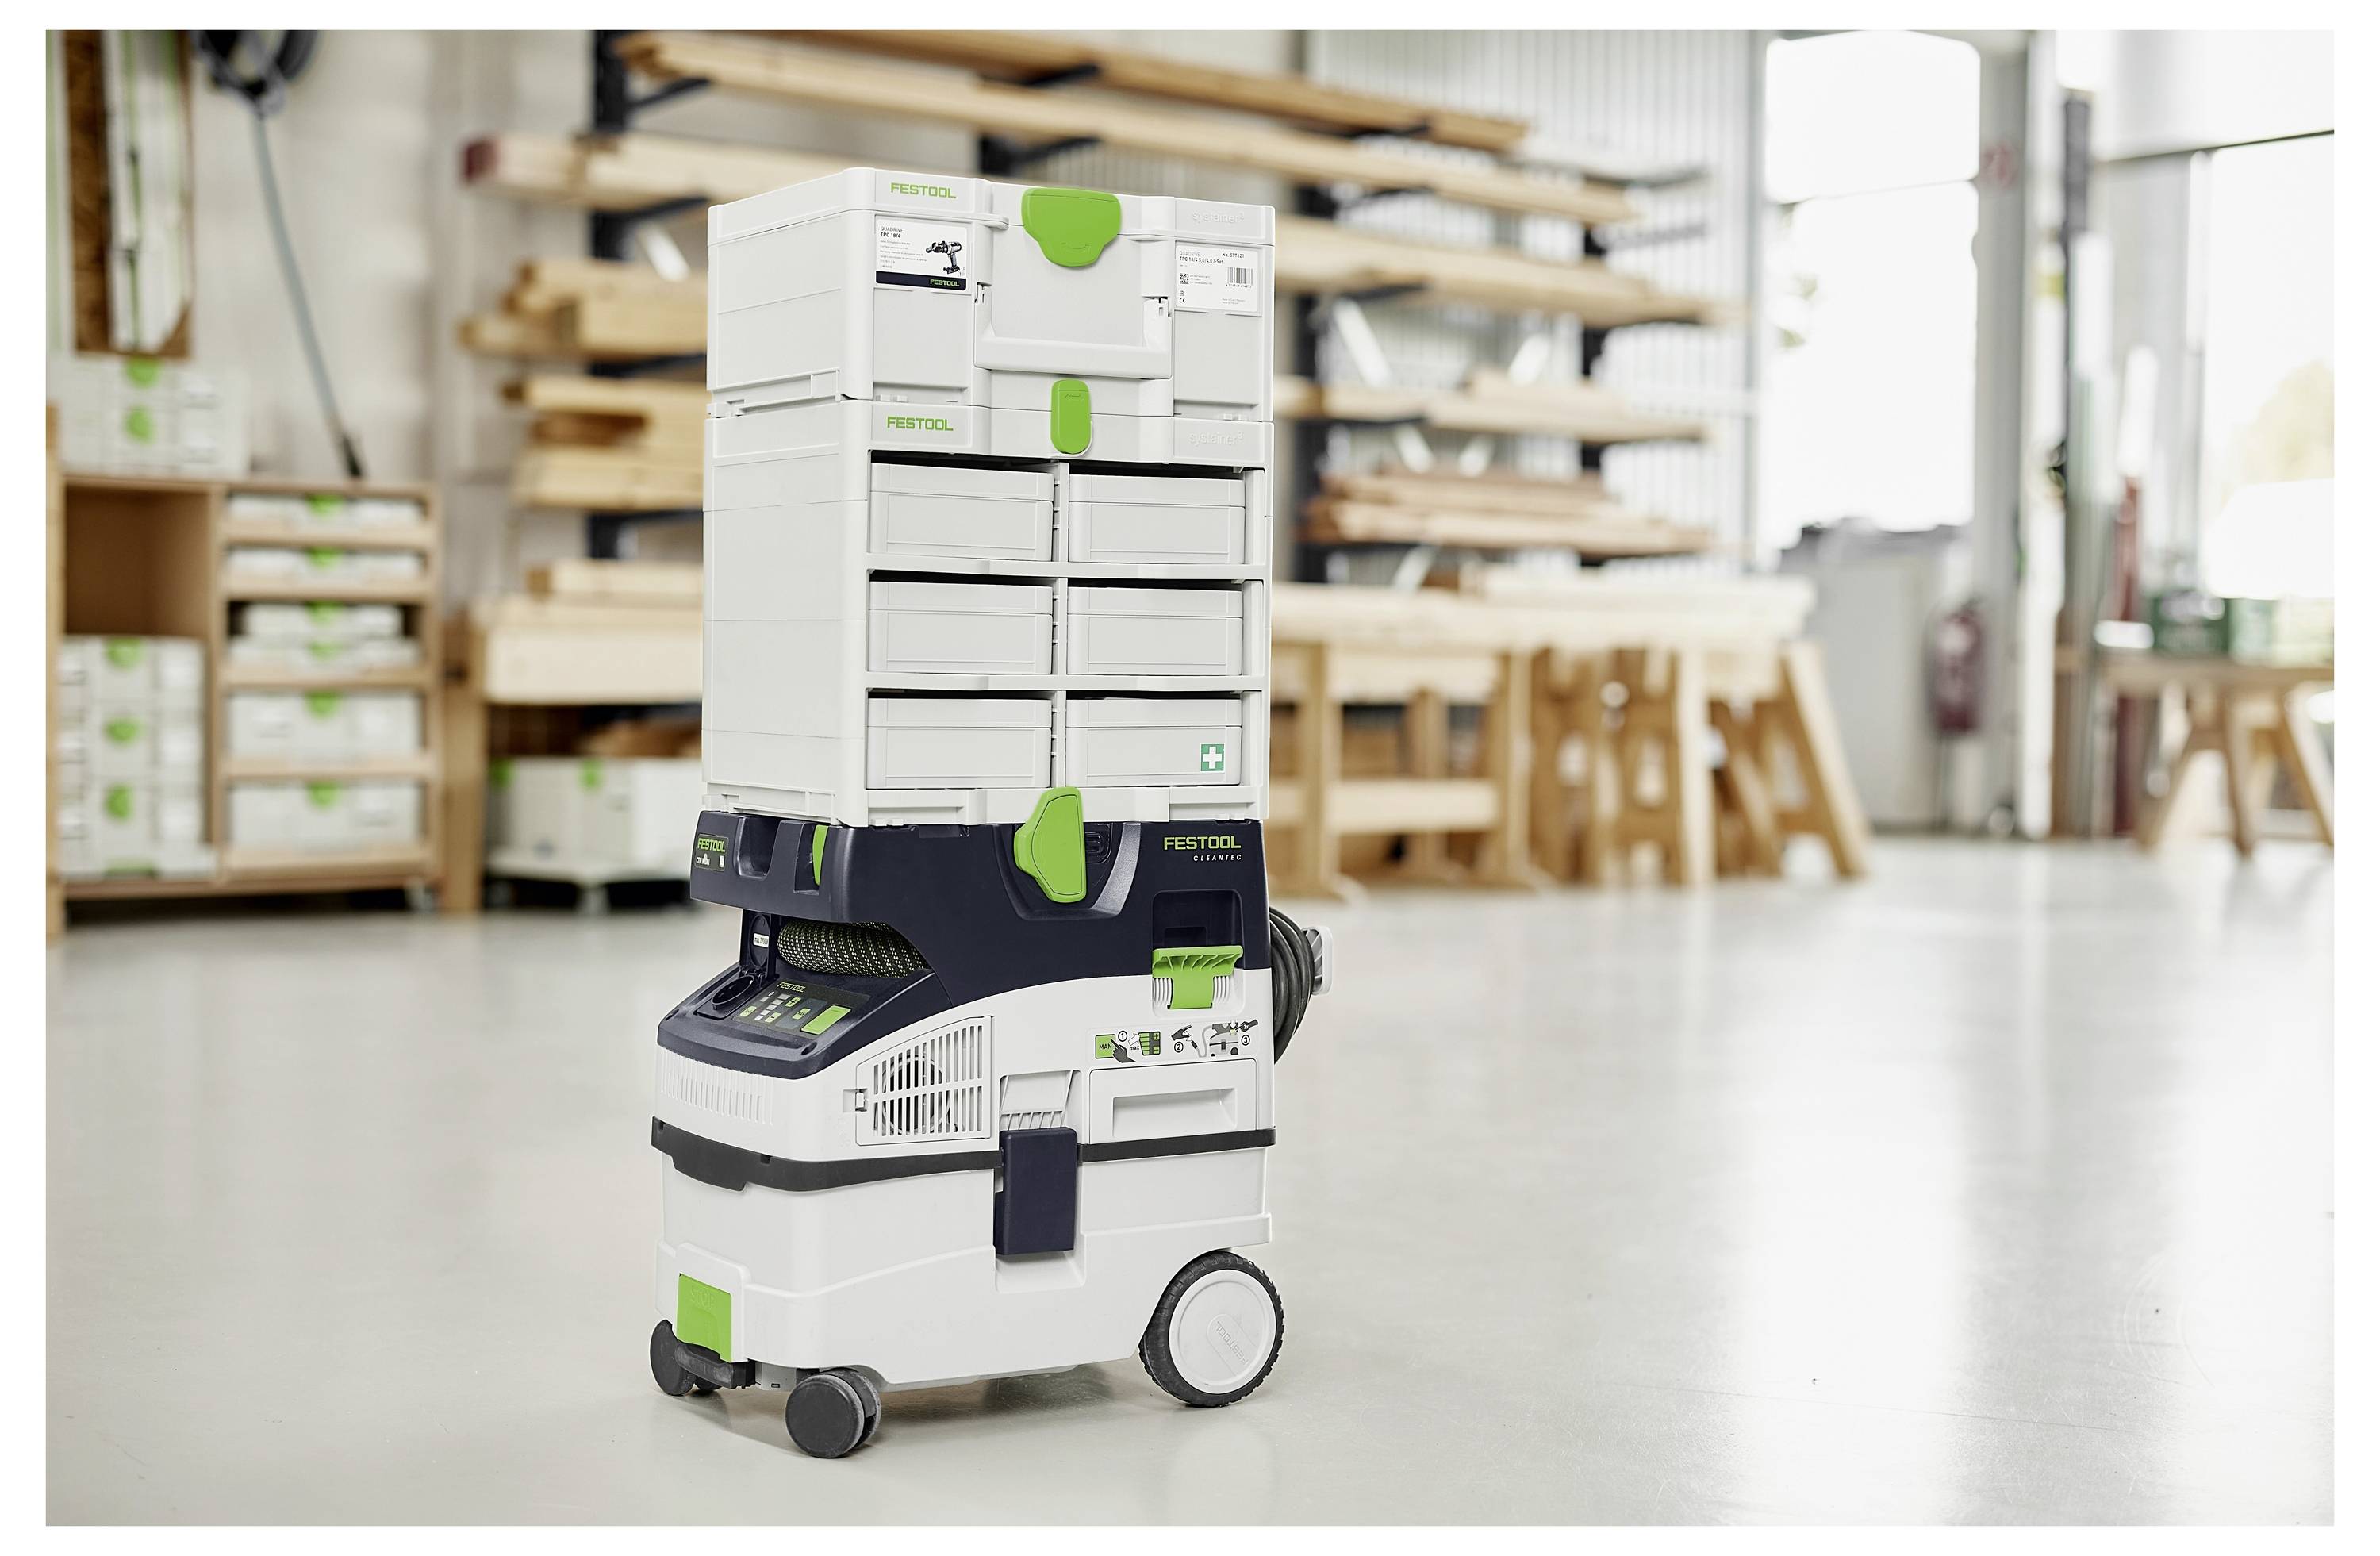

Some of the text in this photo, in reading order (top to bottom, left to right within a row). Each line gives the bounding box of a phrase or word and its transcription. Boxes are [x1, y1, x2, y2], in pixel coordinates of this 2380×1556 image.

[891, 182, 957, 199] FESTOOL
[930, 279, 960, 287] FESTOOL
[887, 416, 954, 431] FESTOOL
[697, 837, 726, 853] FESTOOL
[1164, 836, 1242, 851] FESTOOL
[777, 982, 806, 993] FESTOOL
